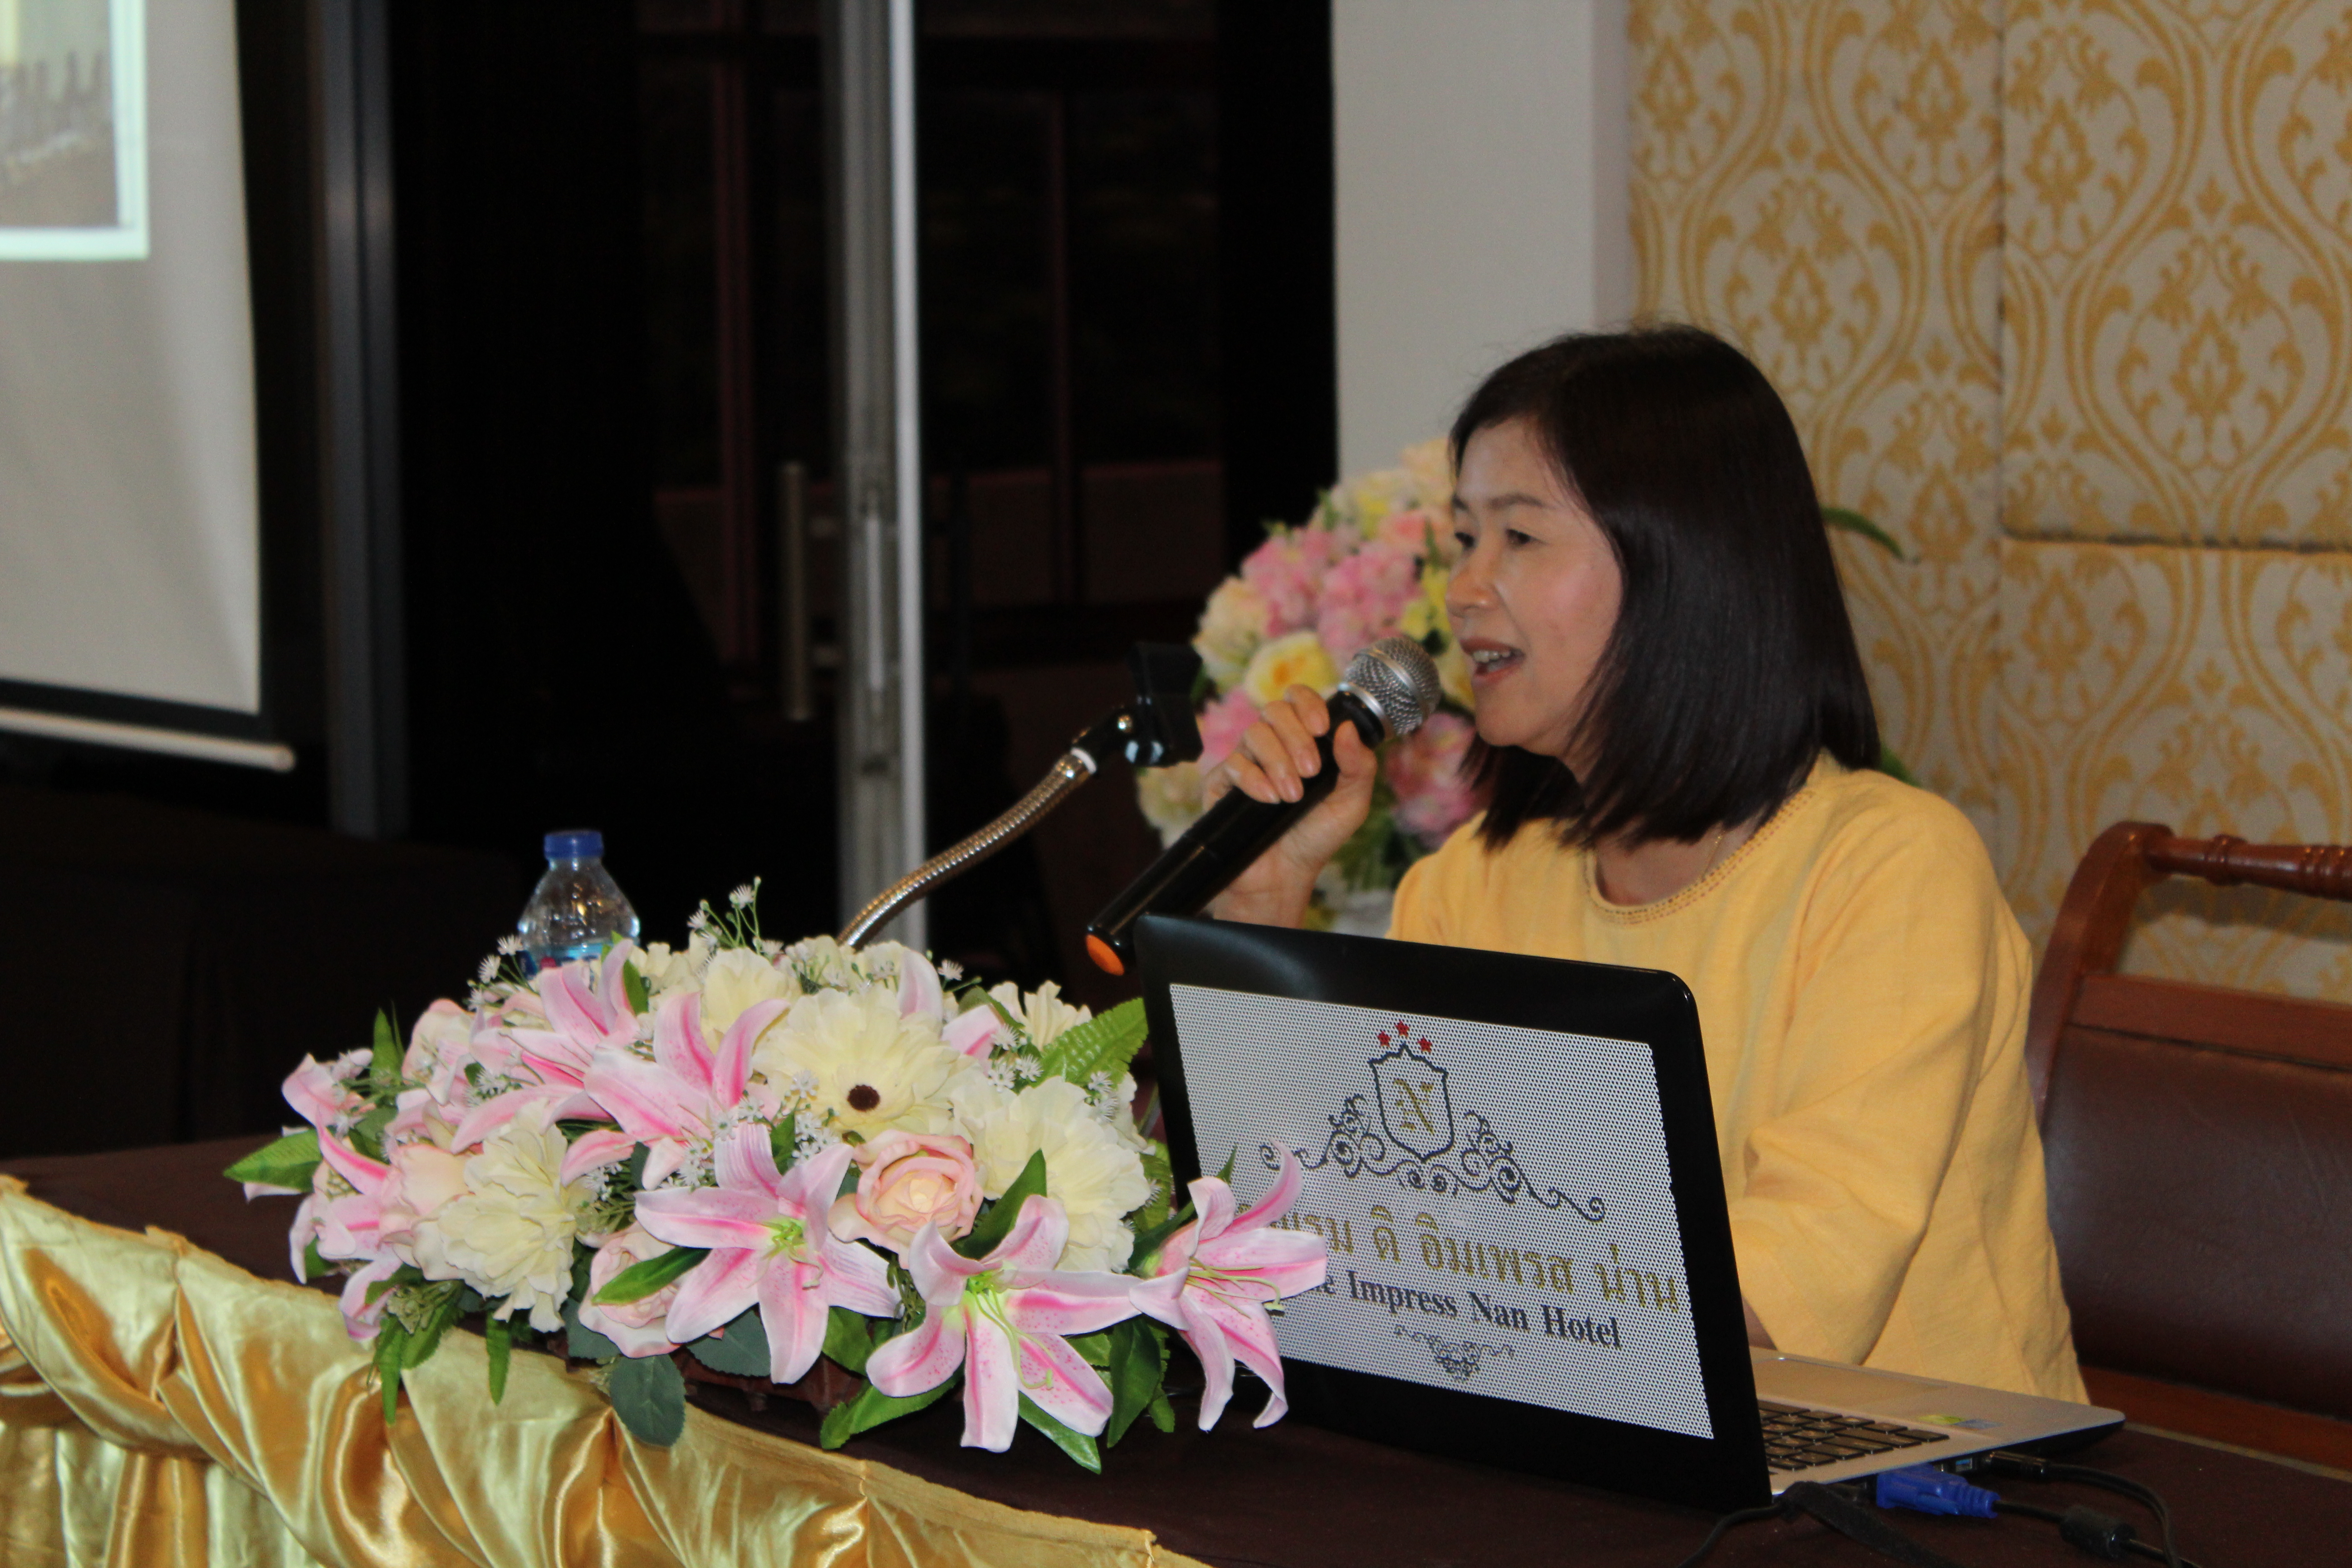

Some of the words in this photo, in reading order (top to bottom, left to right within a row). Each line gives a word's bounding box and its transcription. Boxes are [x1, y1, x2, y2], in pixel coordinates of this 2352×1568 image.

[1415, 1212, 1573, 1294] อิมเพรส
[1593, 1243, 1679, 1313] น่าน
[1346, 1270, 1458, 1318] Impress
[1468, 1291, 1530, 1331] Nan
[1541, 1304, 1622, 1349] Hotel
